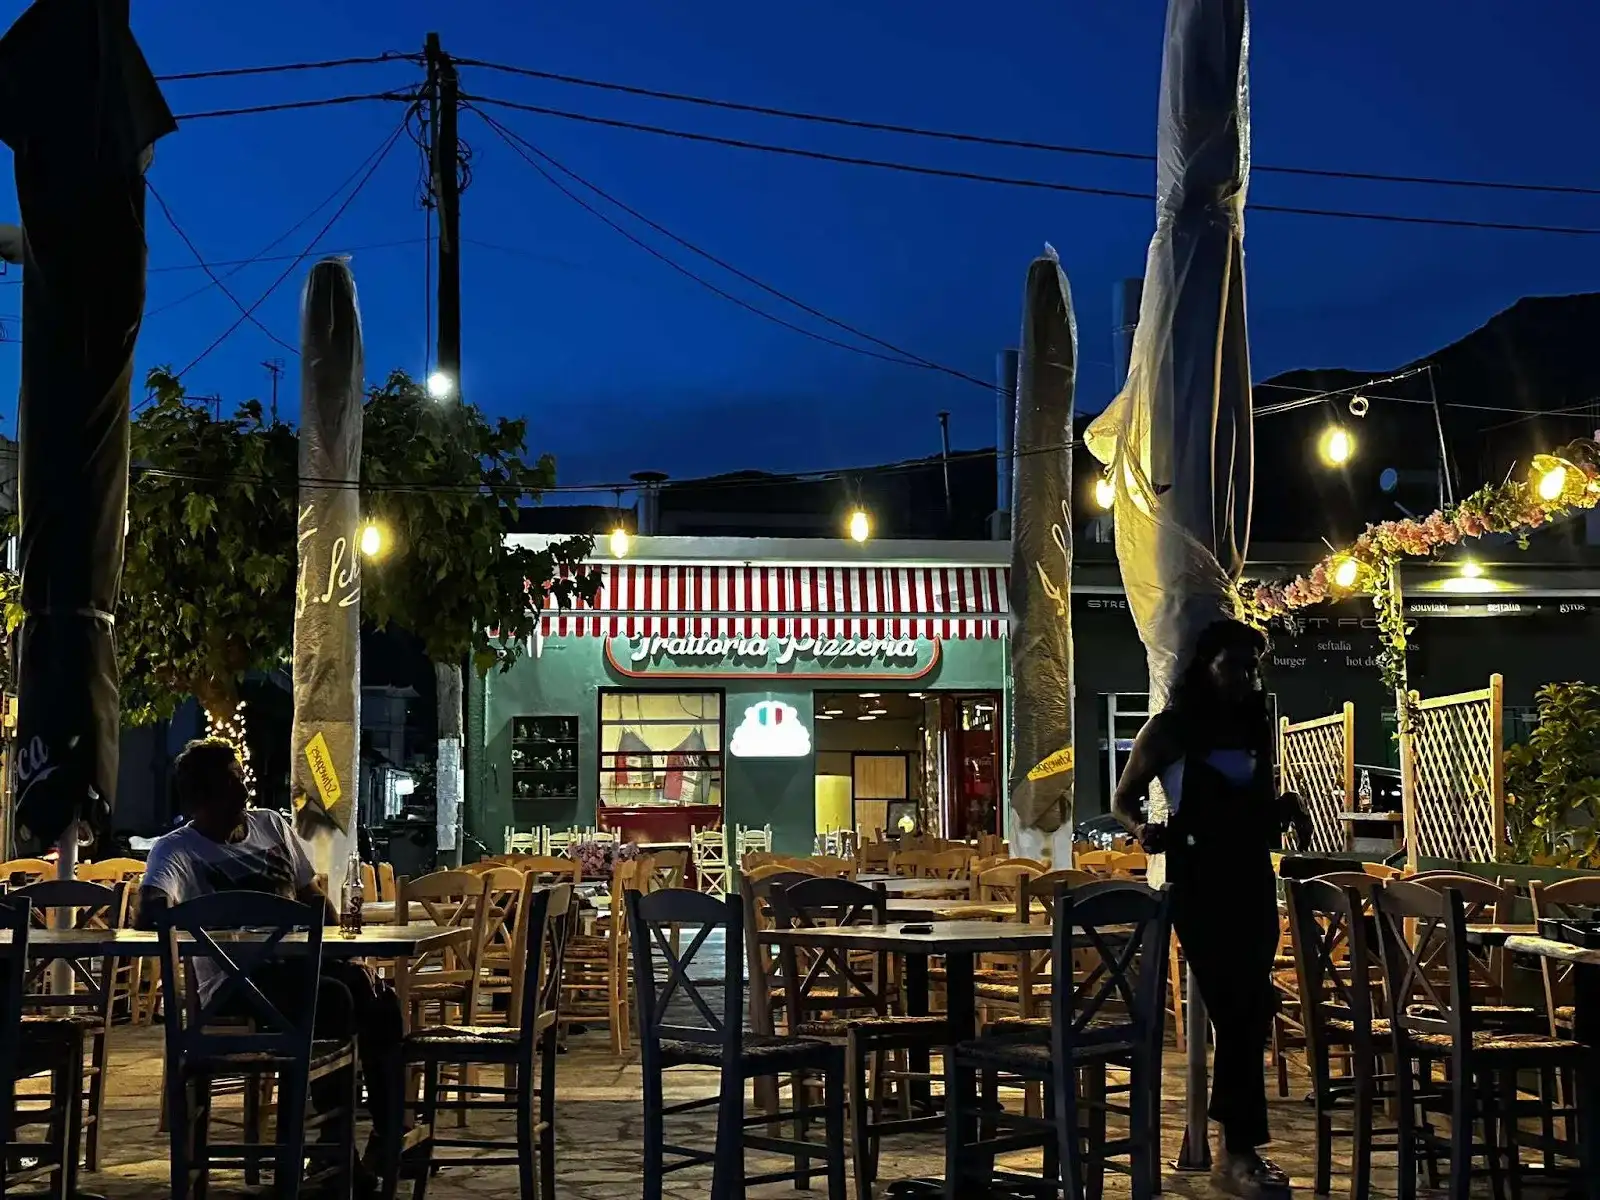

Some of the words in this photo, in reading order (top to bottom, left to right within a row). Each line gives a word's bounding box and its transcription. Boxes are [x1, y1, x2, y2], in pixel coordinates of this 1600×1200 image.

[1087, 600, 1126, 609] STRE
[1559, 604, 1585, 613] gyros
[1337, 617, 1419, 629] FOD
[631, 633, 770, 661] Trattoria
[776, 635, 919, 665] Pizzeria
[1317, 640, 1353, 652] seftalia
[1273, 655, 1307, 669] burger
[1345, 655, 1363, 666] hot
